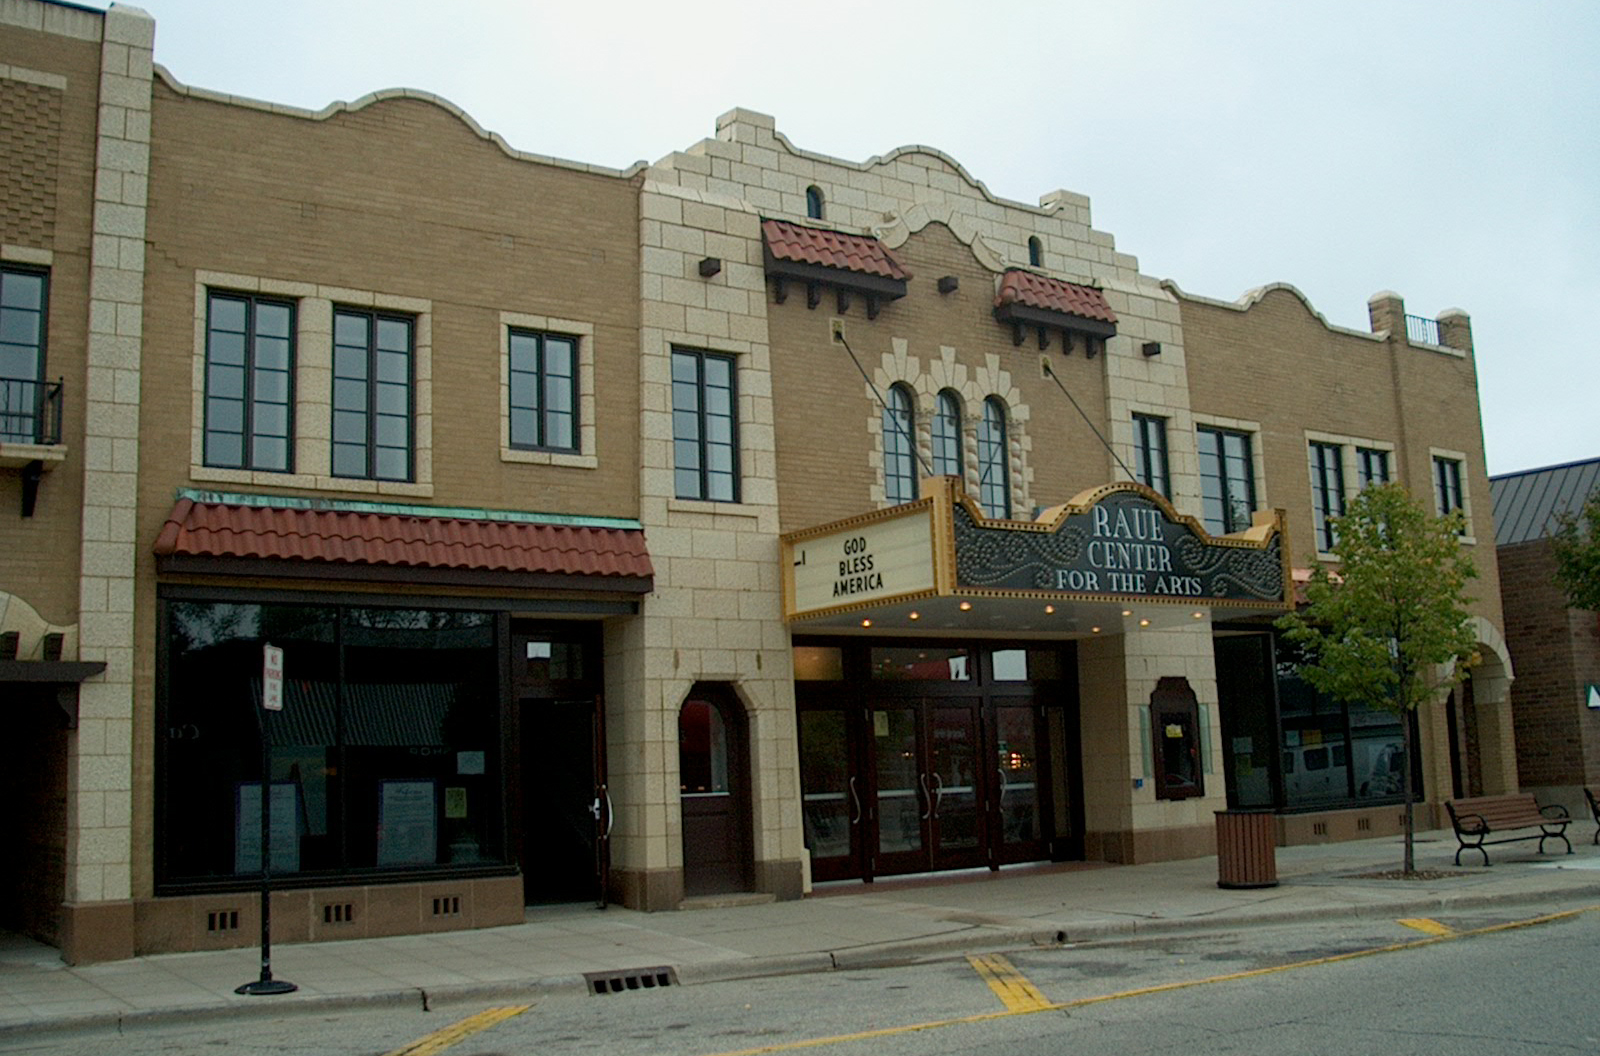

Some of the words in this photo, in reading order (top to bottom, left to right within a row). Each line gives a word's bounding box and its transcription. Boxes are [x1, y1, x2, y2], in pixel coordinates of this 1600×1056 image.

[1093, 504, 1164, 542] RAUE
[843, 536, 867, 556] GOD
[1087, 540, 1173, 572] CENTER
[839, 554, 874, 577] BLESS
[833, 572, 883, 598] AMERICA
[1055, 569, 1100, 591] FOR
[1107, 572, 1147, 593] THE
[1154, 575, 1203, 596] ARTS
